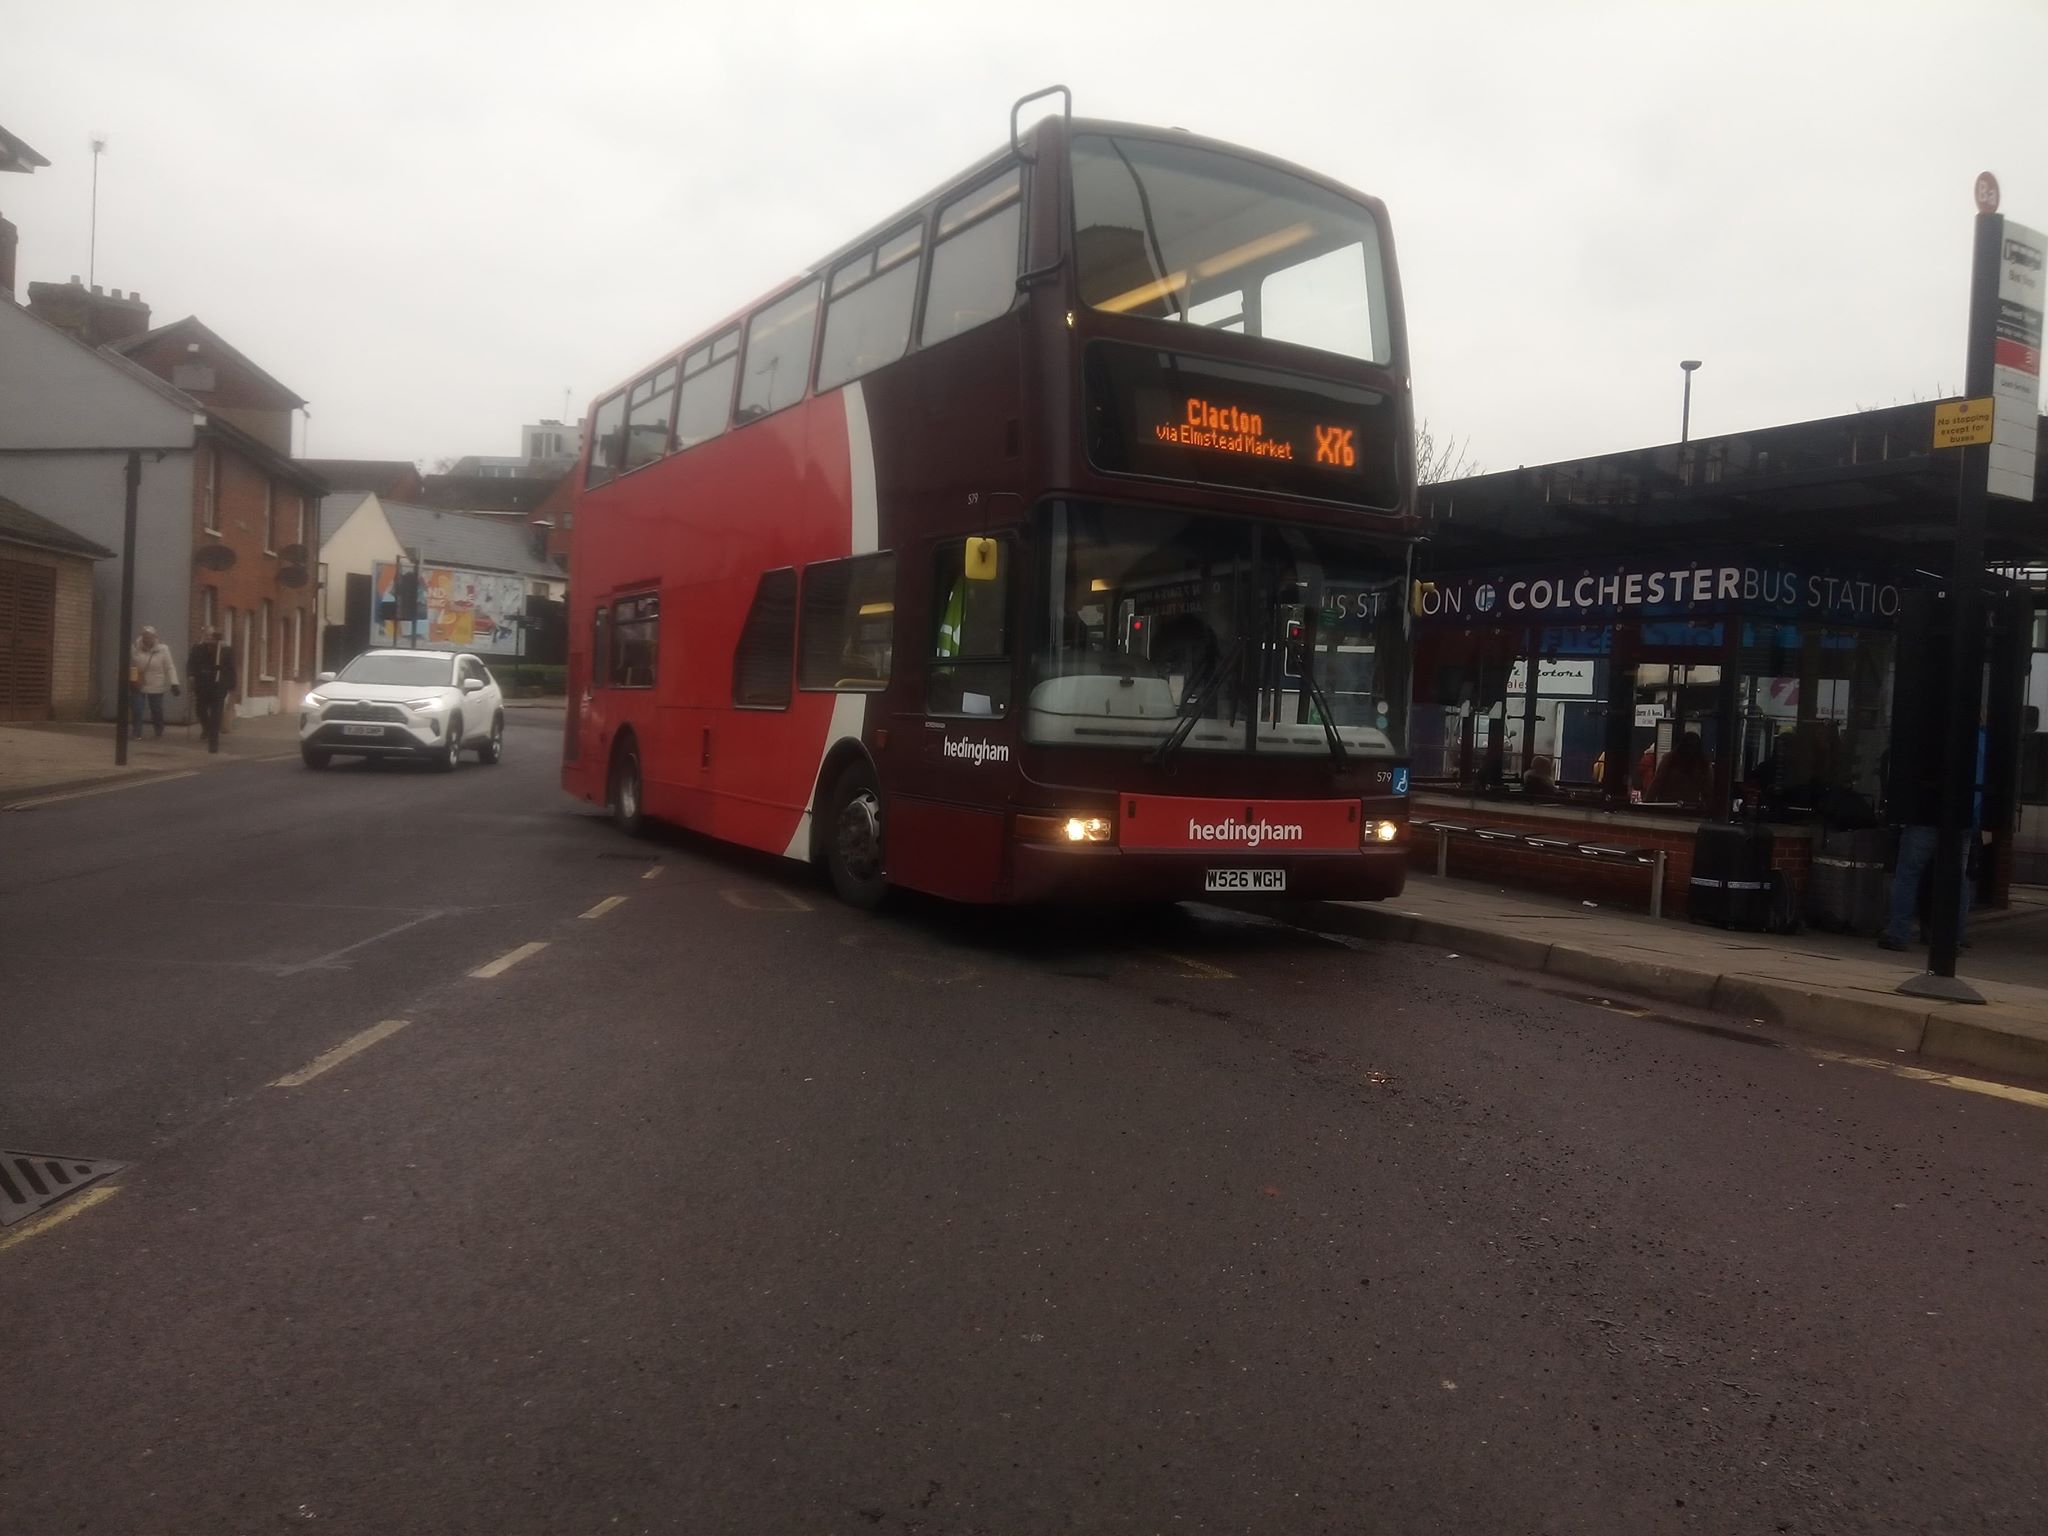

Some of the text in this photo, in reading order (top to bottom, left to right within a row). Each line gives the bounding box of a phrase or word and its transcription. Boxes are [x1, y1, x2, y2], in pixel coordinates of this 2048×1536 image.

[1186, 397, 1263, 435] Clacton
[1937, 414, 1990, 426] No stopping
[1156, 422, 1178, 442] via
[1940, 423, 1985, 436] except for
[1949, 434, 1975, 443] buses
[1314, 424, 1356, 467] X76
[1423, 567, 1899, 617] ON COLCHESTER BUS STATIO
[944, 734, 1009, 766] hedingham
[1376, 771, 1392, 783] 579
[1189, 817, 1303, 847] hedingham
[1207, 871, 1283, 888] W526 WGH
